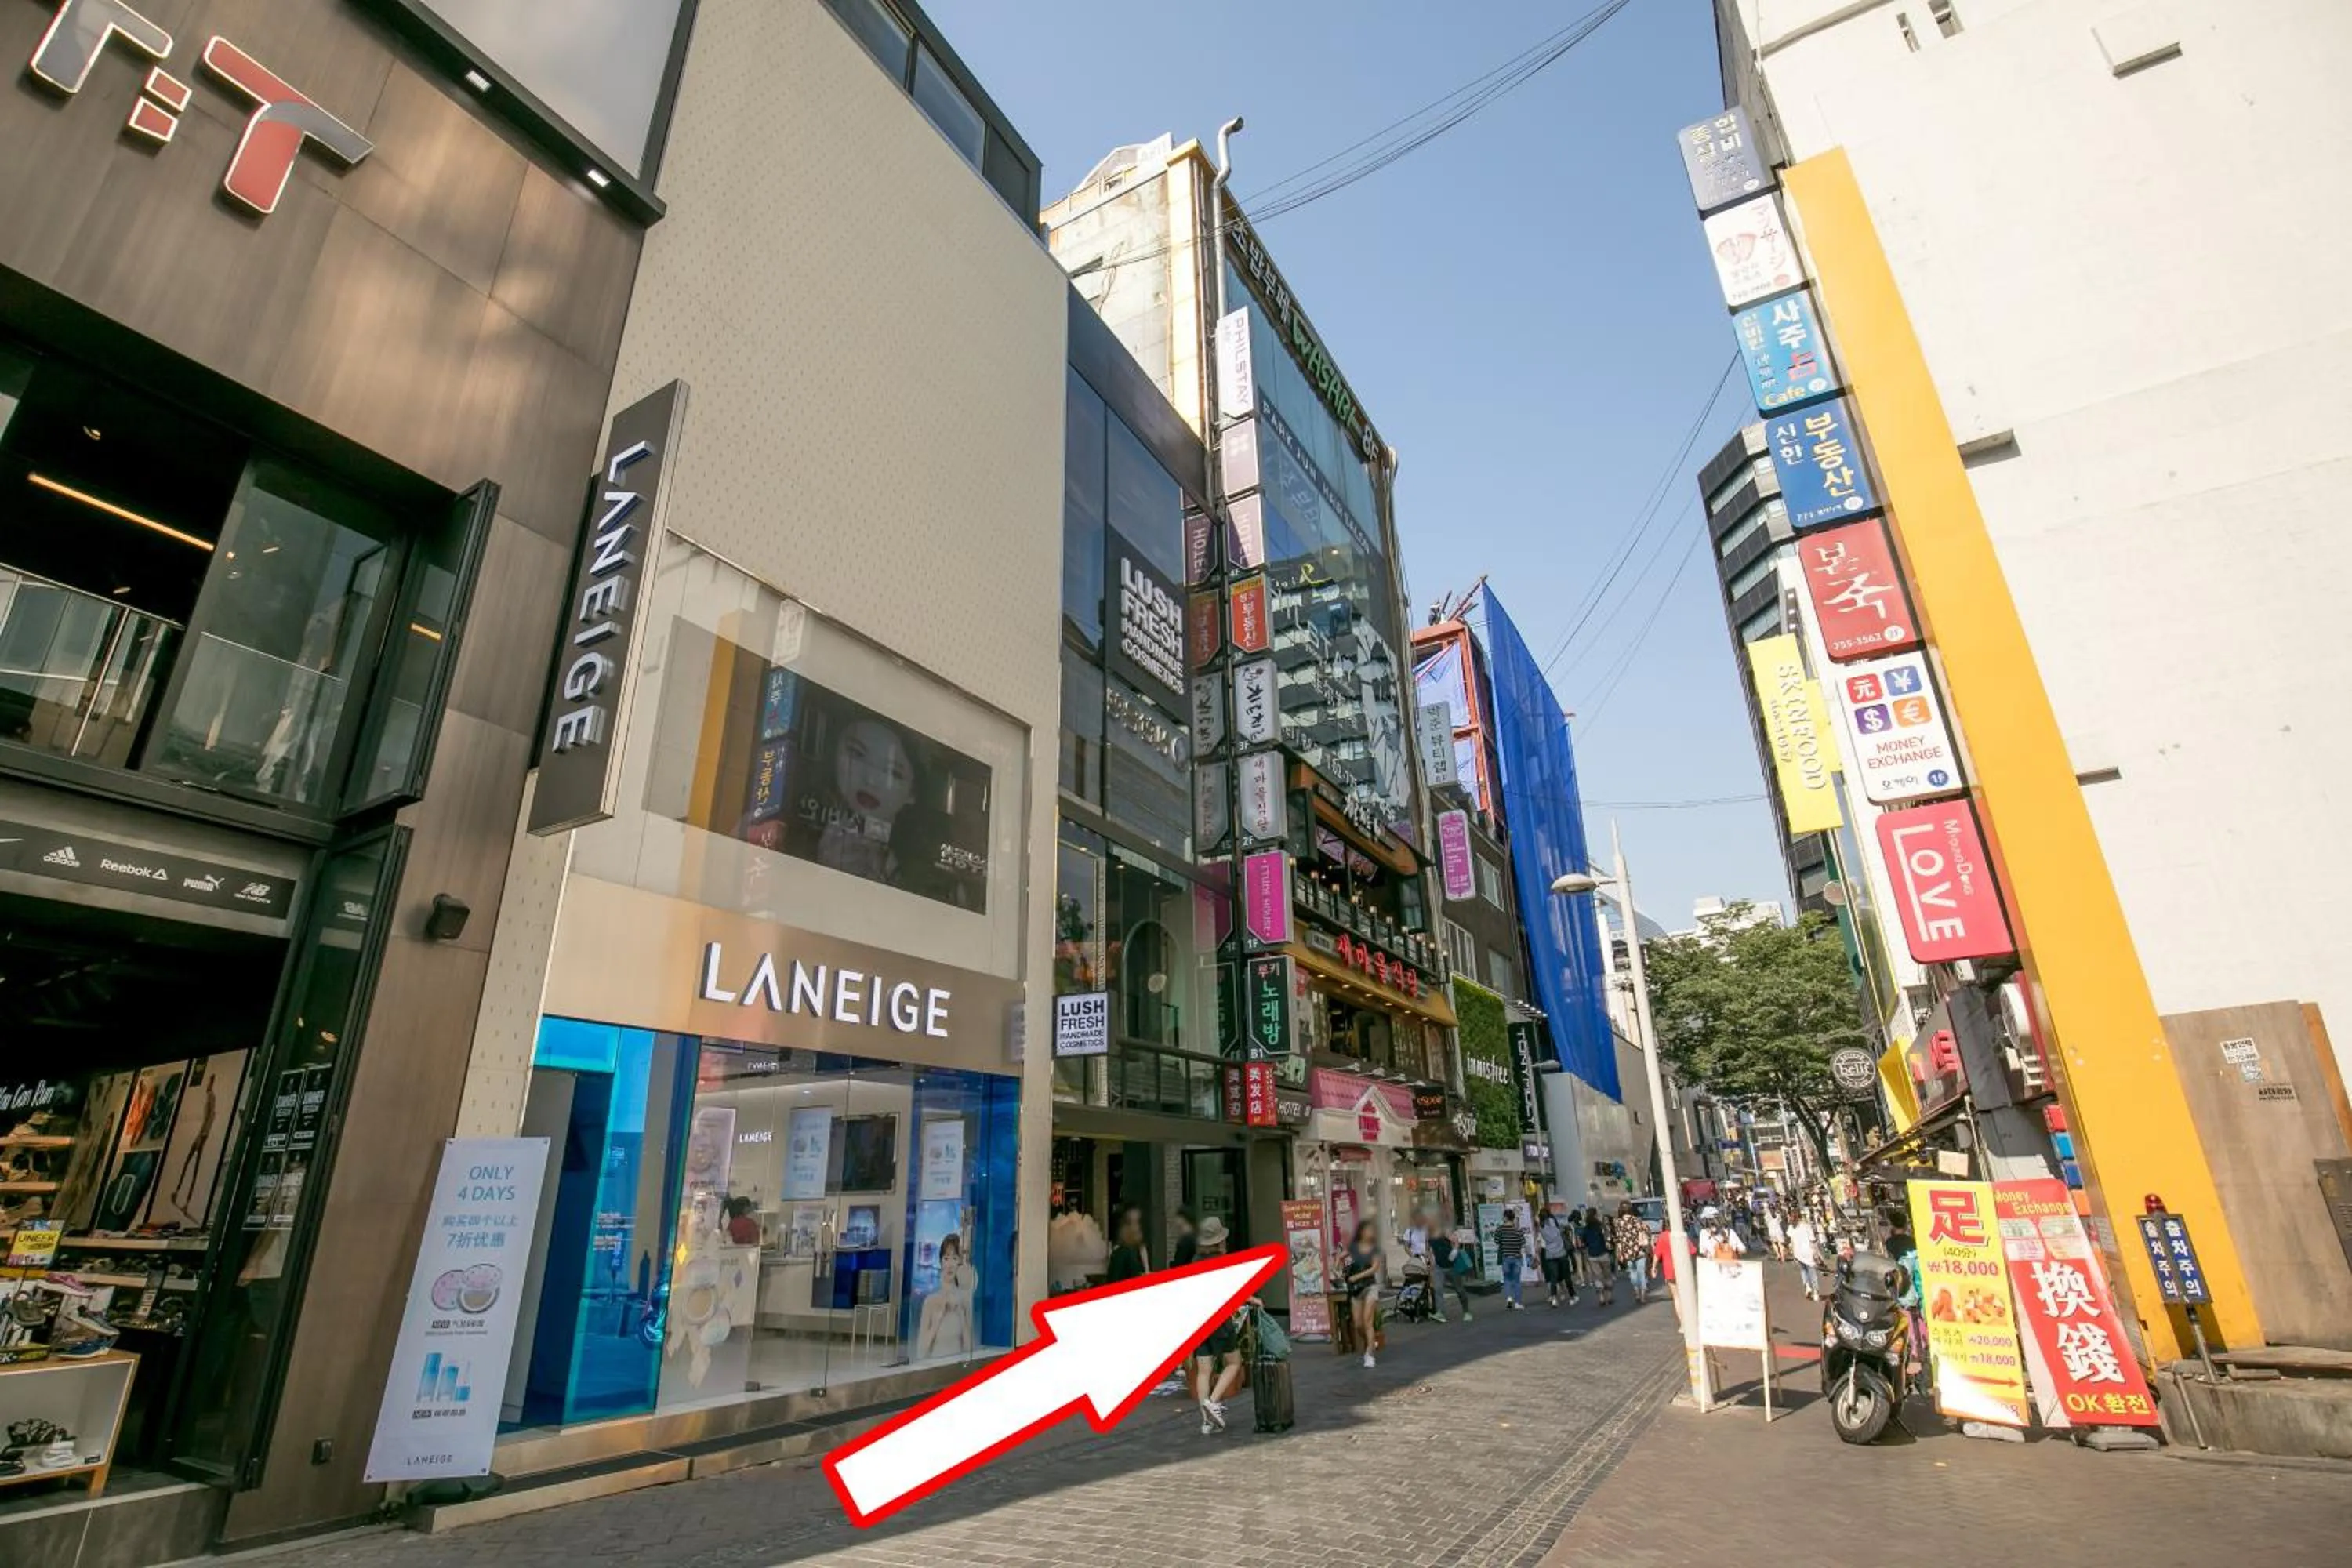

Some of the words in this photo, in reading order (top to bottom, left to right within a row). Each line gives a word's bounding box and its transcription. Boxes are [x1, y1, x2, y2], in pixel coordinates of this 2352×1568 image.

[1773, 299, 1806, 350] 사주
[1233, 316, 1248, 405] PHILSTAY
[1765, 386, 1806, 407] Cafe
[1805, 412, 1854, 497] 부동산
[551, 440, 655, 755] LANEIGE
[1121, 557, 1182, 633] LUSH
[1121, 589, 1182, 659] FRESH
[1853, 679, 1876, 699] 元
[1780, 666, 1825, 790] SKINFOOD
[1876, 736, 1925, 753] MONEY
[1867, 747, 1943, 769] EXCHANGE
[100, 858, 151, 877] Reebok
[1893, 824, 1965, 942] LOVE
[700, 941, 953, 1038] LANEIGE
[1061, 1000, 1105, 1017] LUSH
[1061, 1016, 1105, 1031] FRESH
[1261, 981, 1281, 1044] 노래방
[1060, 1029, 1104, 1040] HANDMADE
[1060, 1039, 1105, 1049] COSMETICS
[469, 1166, 514, 1181] ONLY
[458, 1186, 467, 1201] 4
[472, 1185, 516, 1201] DAYS
[2013, 1201, 2071, 1214] Exchange
[1929, 1189, 1990, 1247] 足
[2165, 1219, 2202, 1297] 출차주의
[2031, 1260, 2125, 1384] 換錢
[2067, 1393, 2104, 1413] OK
[2106, 1395, 2151, 1416] 환전
